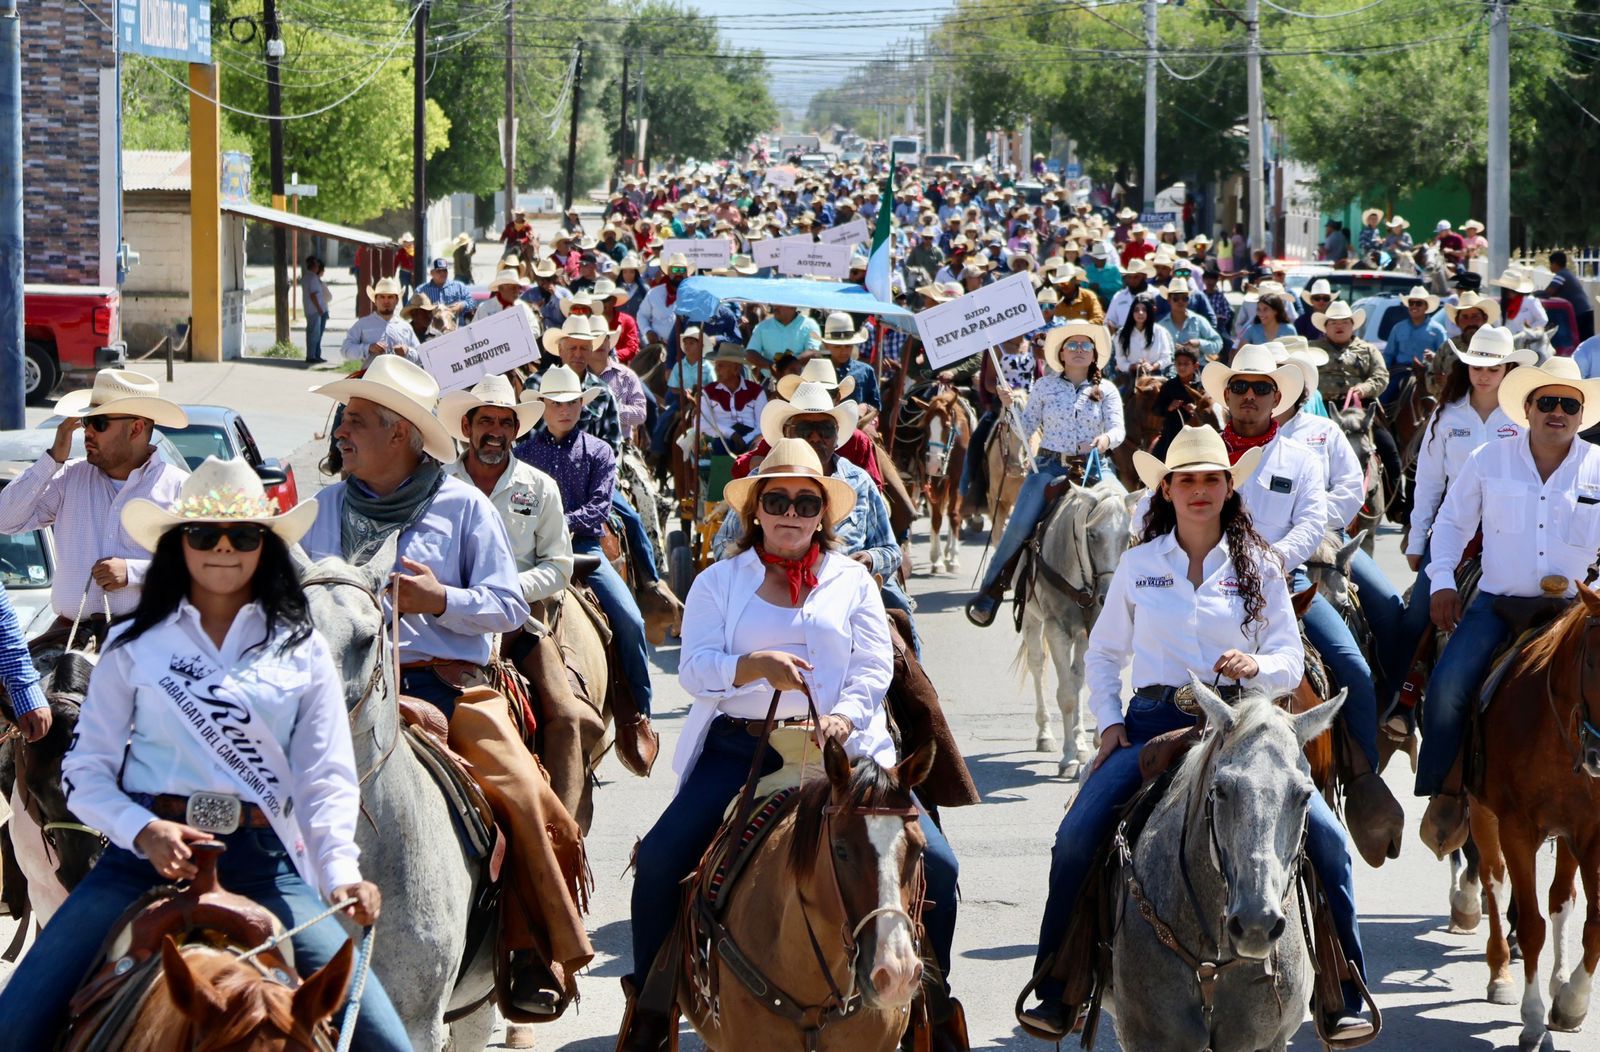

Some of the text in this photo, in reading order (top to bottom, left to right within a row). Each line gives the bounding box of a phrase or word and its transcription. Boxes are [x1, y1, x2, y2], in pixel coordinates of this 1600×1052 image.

[934, 303, 1028, 347] RIVAPALACIO
[964, 305, 991, 321] EJIDO
[450, 342, 511, 373] EL MEZQUITE
[463, 338, 490, 353] EJIDO
[158, 675, 206, 733] CABALGATA
[200, 724, 219, 749] DEL
[216, 744, 267, 796] CAMPESINO
[185, 680, 281, 788] Reina
